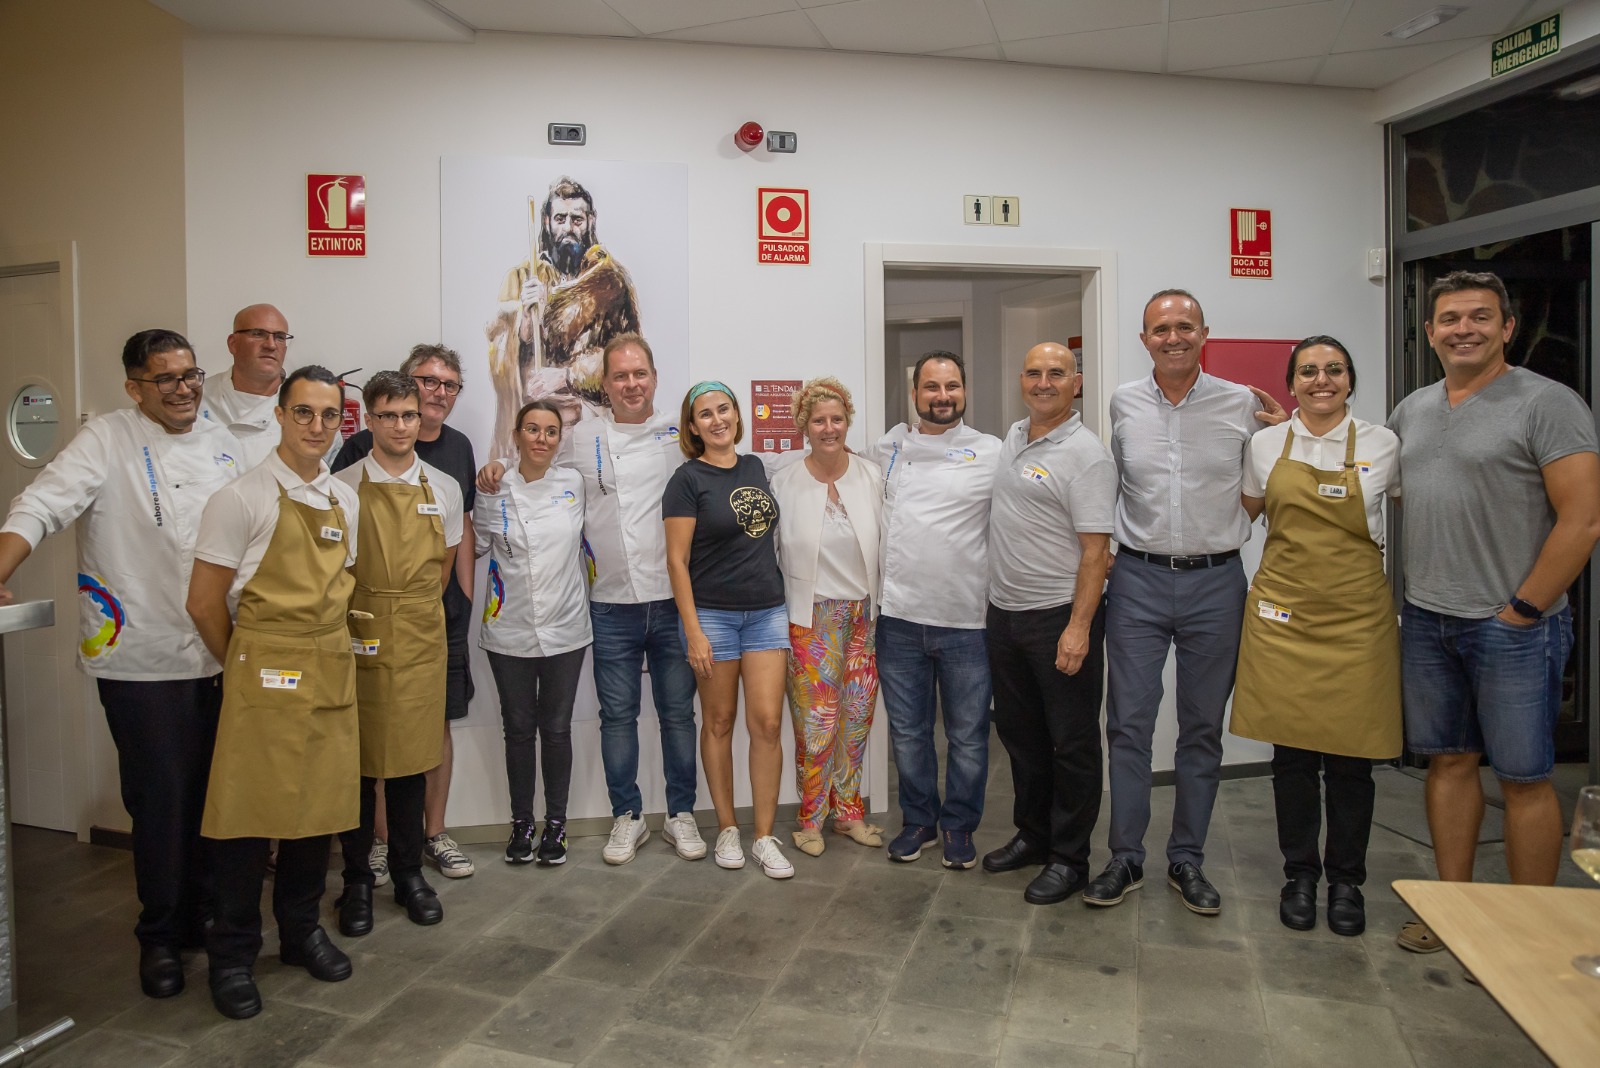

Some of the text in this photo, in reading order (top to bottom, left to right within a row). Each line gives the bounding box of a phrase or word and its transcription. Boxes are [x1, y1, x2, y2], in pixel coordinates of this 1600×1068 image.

[1495, 18, 1556, 57] SALIDA DE
[1492, 35, 1558, 75] EMERGENCIA
[310, 237, 363, 251] EXTINTOR
[762, 244, 805, 253] PULSADOR
[761, 253, 806, 262] DE ALARMA
[1233, 259, 1255, 267] BOCA
[1233, 268, 1269, 276] INCENDIO
[143, 446, 163, 527] saborealapalma.es
